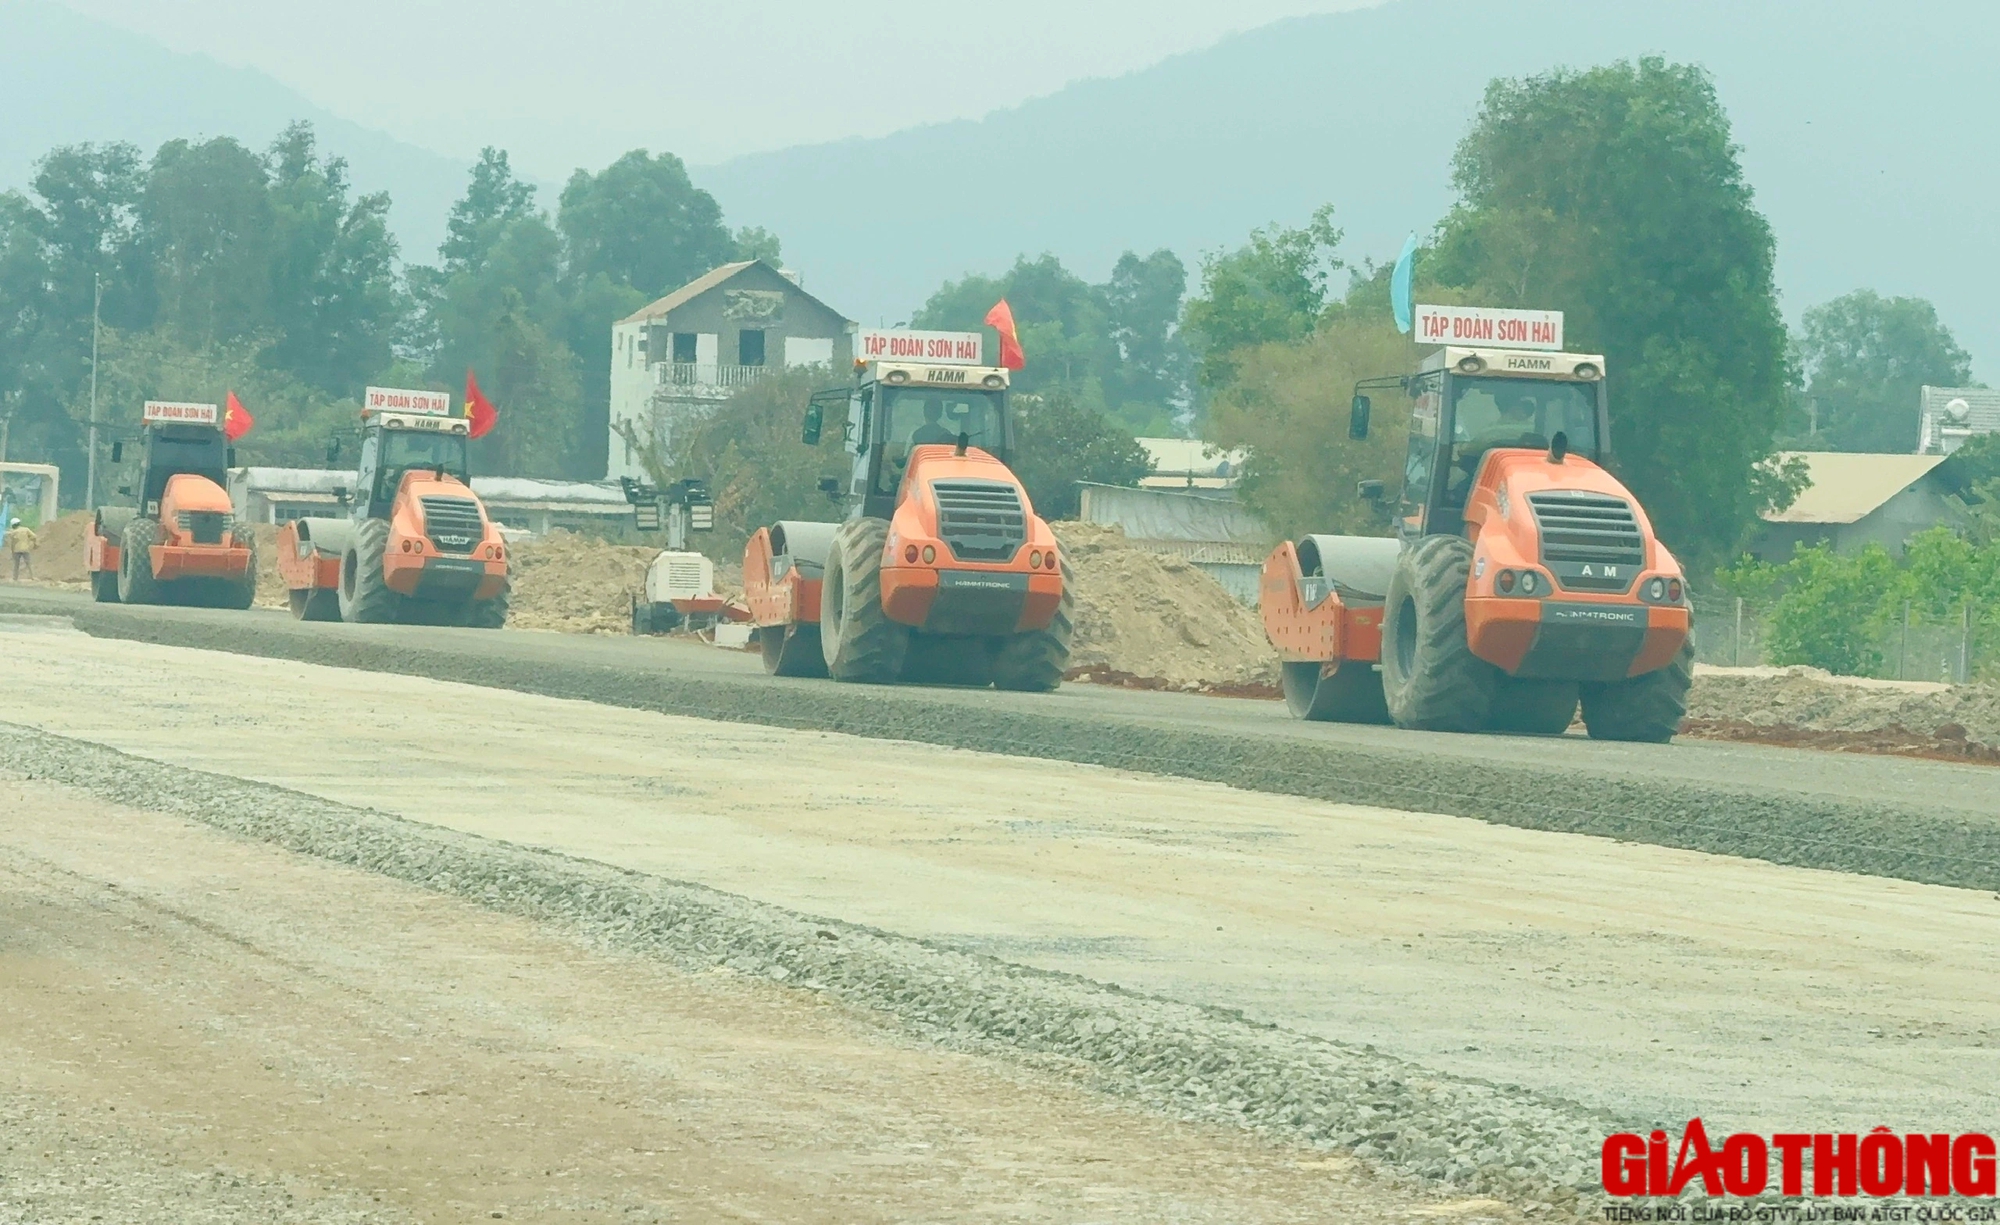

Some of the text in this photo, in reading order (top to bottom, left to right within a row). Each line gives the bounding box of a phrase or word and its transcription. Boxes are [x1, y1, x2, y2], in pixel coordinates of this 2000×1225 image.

[1422, 311, 1556, 343] TẬP ĐOÀN SƠN HẢI
[864, 333, 977, 360] TẬP ĐOÀN SƠN HẢI
[1507, 358, 1551, 370] HAMM
[927, 370, 965, 383] HAMM
[414, 419, 440, 429] HAMM
[955, 580, 1011, 589] HAMMTRONIC
